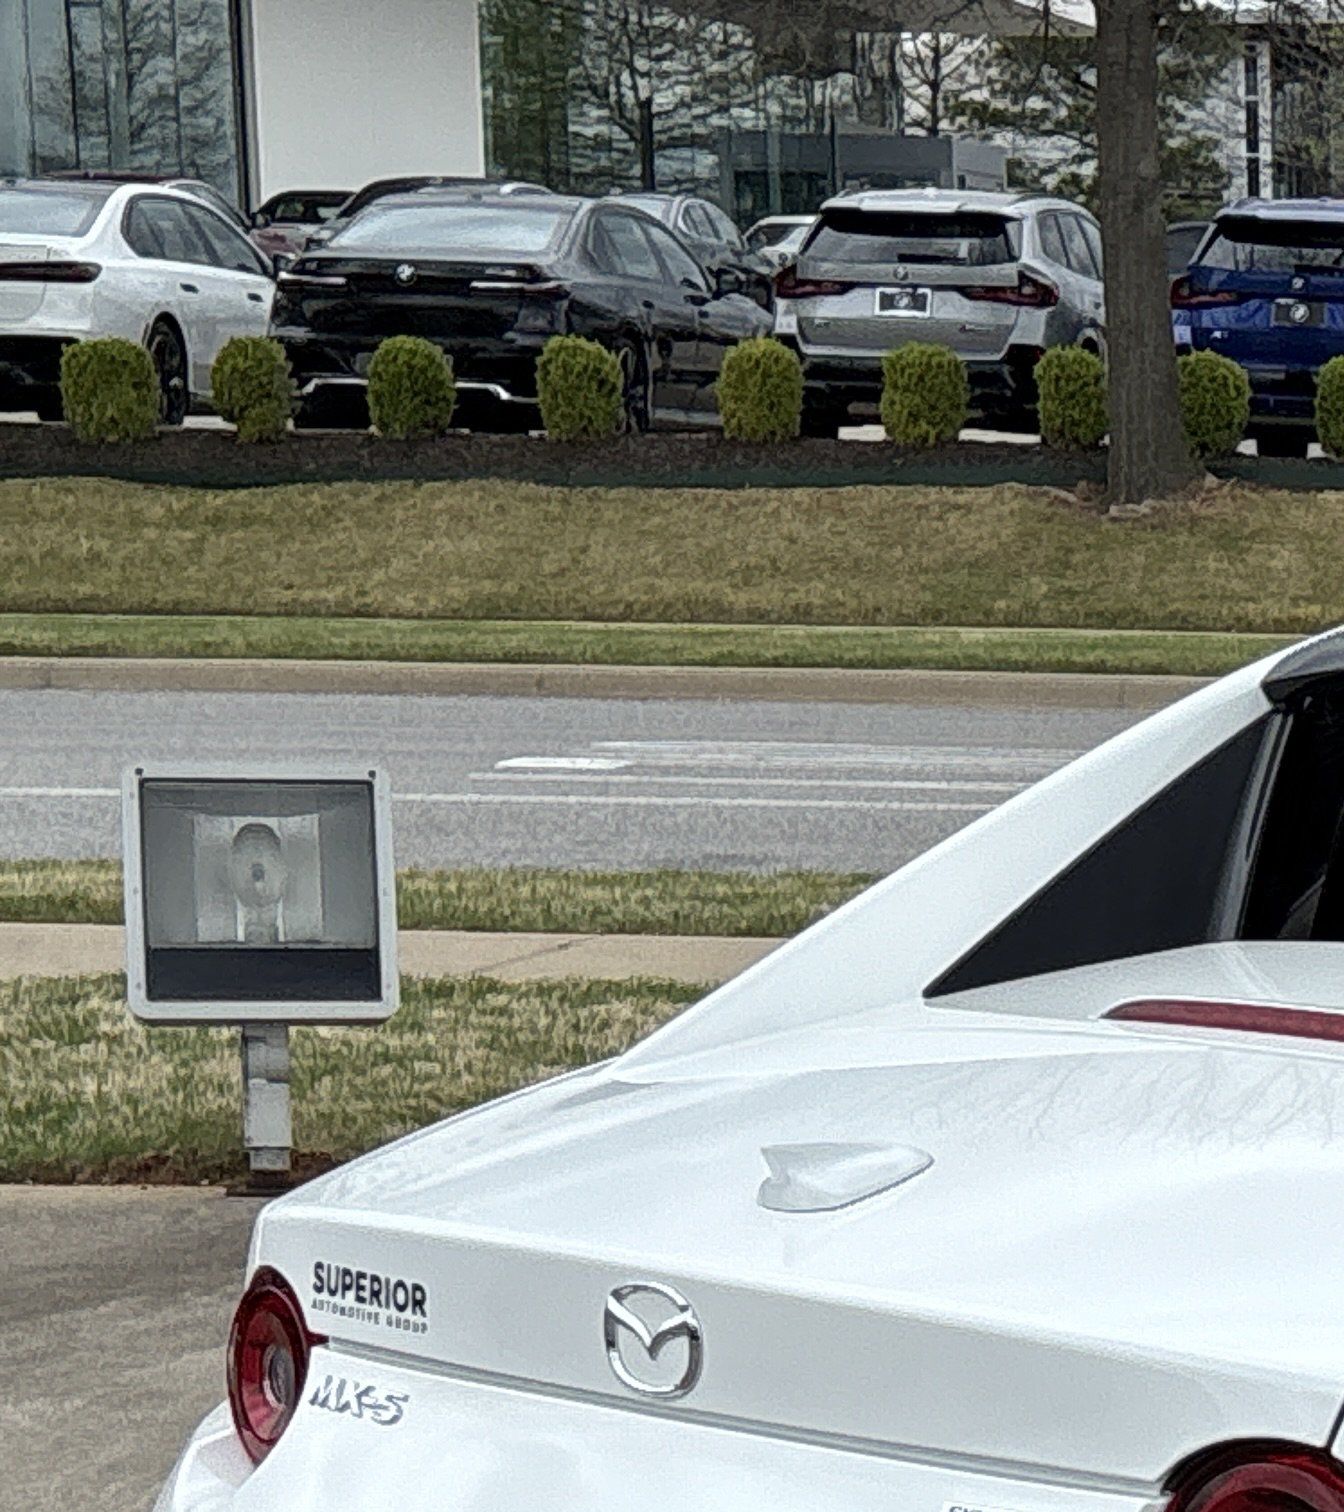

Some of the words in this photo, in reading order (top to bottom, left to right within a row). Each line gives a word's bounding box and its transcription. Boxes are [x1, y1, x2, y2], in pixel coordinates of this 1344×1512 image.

[311, 1297, 380, 1326] AUTOMOTIVE
[386, 1314, 429, 1334] GROUP
[313, 1261, 428, 1318] SUPERIOR
[308, 1374, 410, 1426] MX-5
